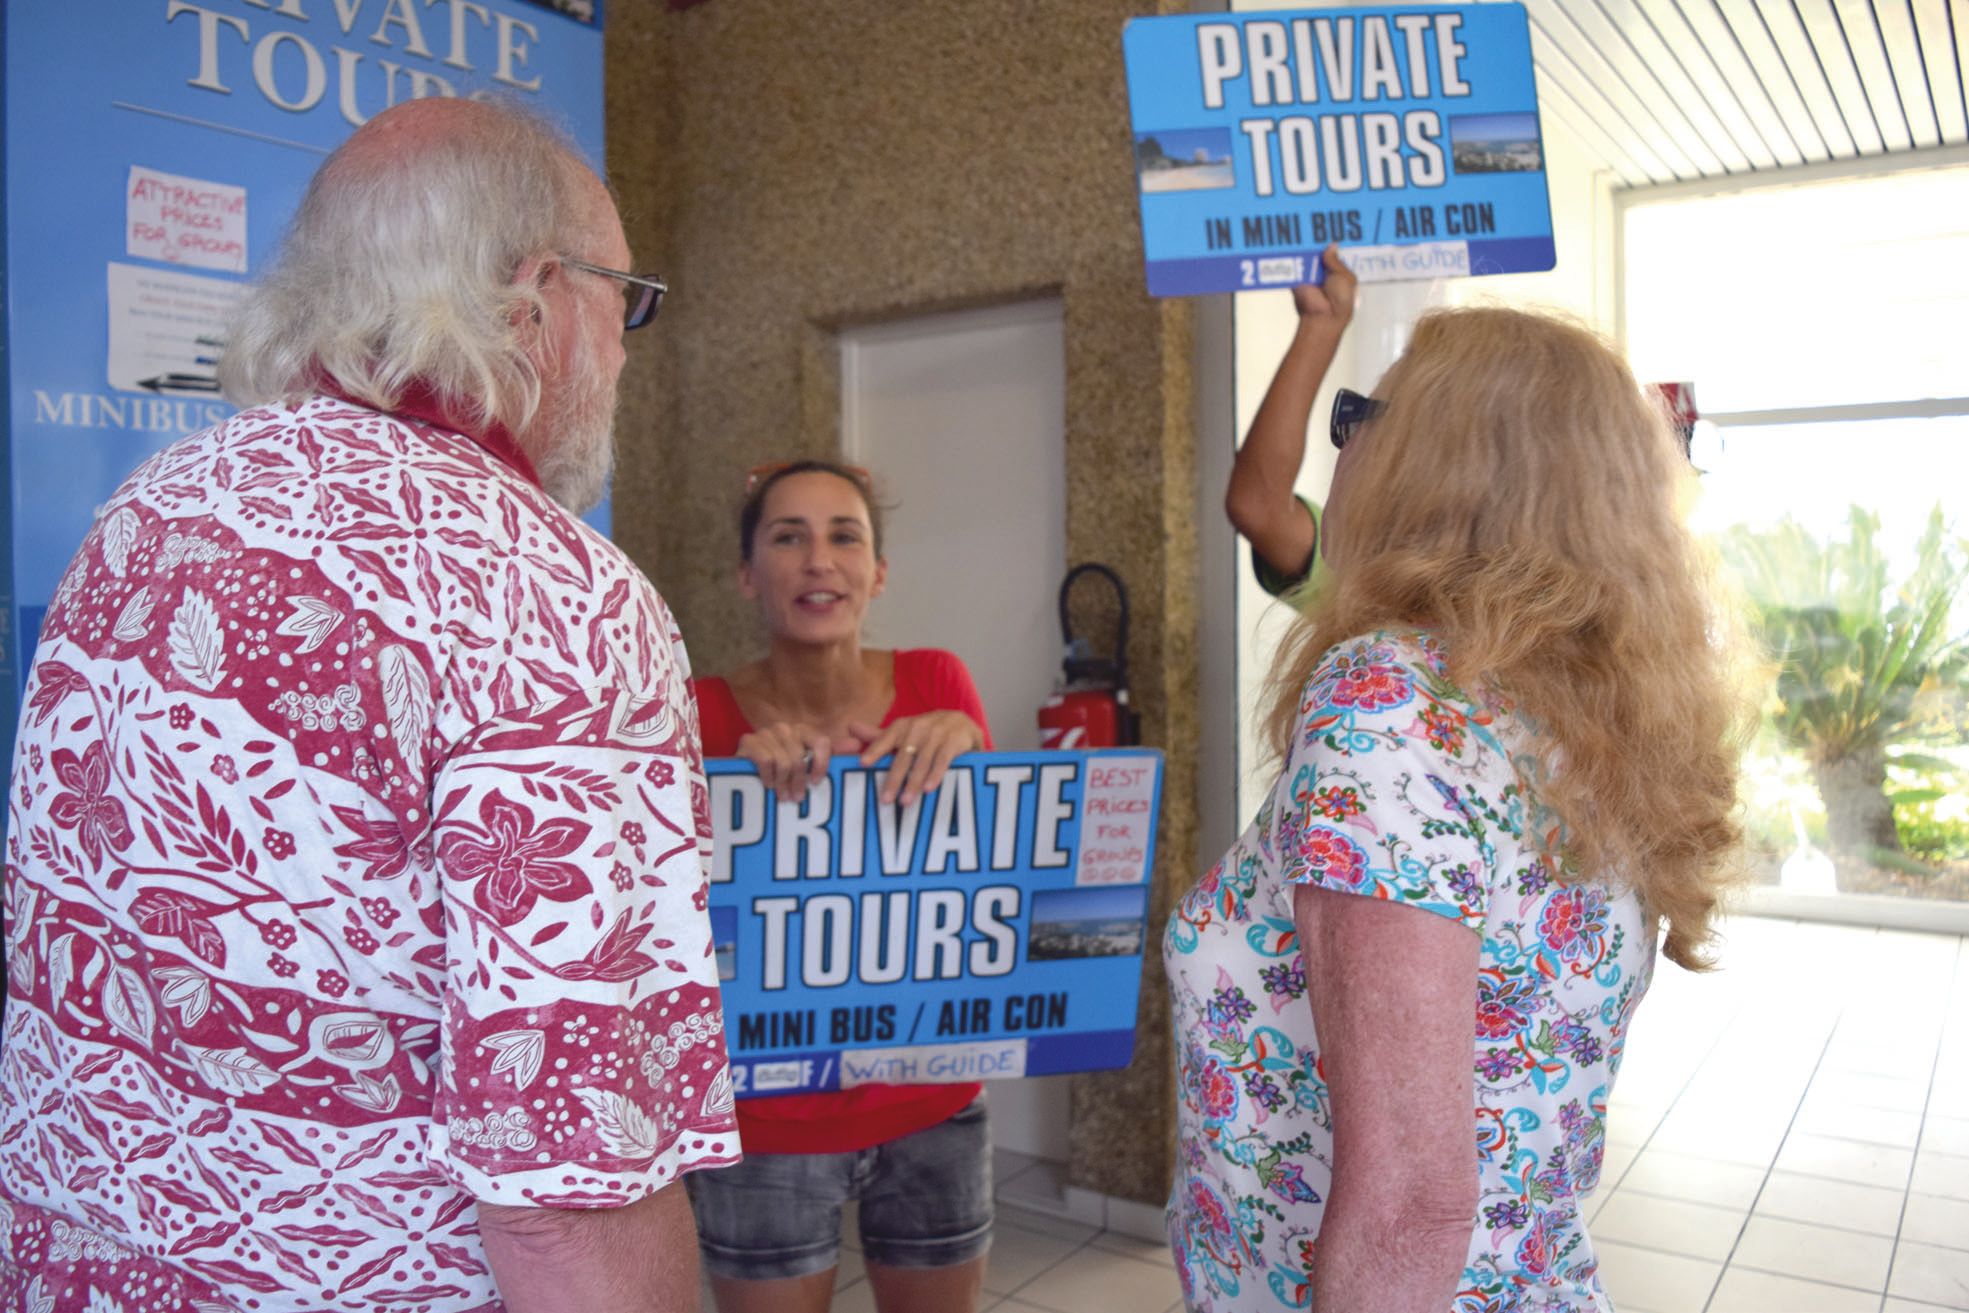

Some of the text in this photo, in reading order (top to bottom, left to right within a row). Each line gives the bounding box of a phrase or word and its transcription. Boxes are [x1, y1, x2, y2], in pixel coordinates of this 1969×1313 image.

[167, 2, 498, 128] TOU
[1197, 13, 1470, 109] PRIVATE
[1241, 110, 1447, 197] TOURS
[1205, 202, 1496, 250] IN MINI BUS / AIR CON
[1241, 260, 1255, 286] 2
[33, 391, 227, 433] MINIBUS
[1089, 767, 1148, 789] BEST
[711, 763, 1077, 882] PRIVATE
[1097, 825, 1131, 839] FOR
[753, 885, 1020, 991] TOURS
[738, 992, 1069, 1050] MINI BUS / AIR CON
[731, 1065, 748, 1093] 2
